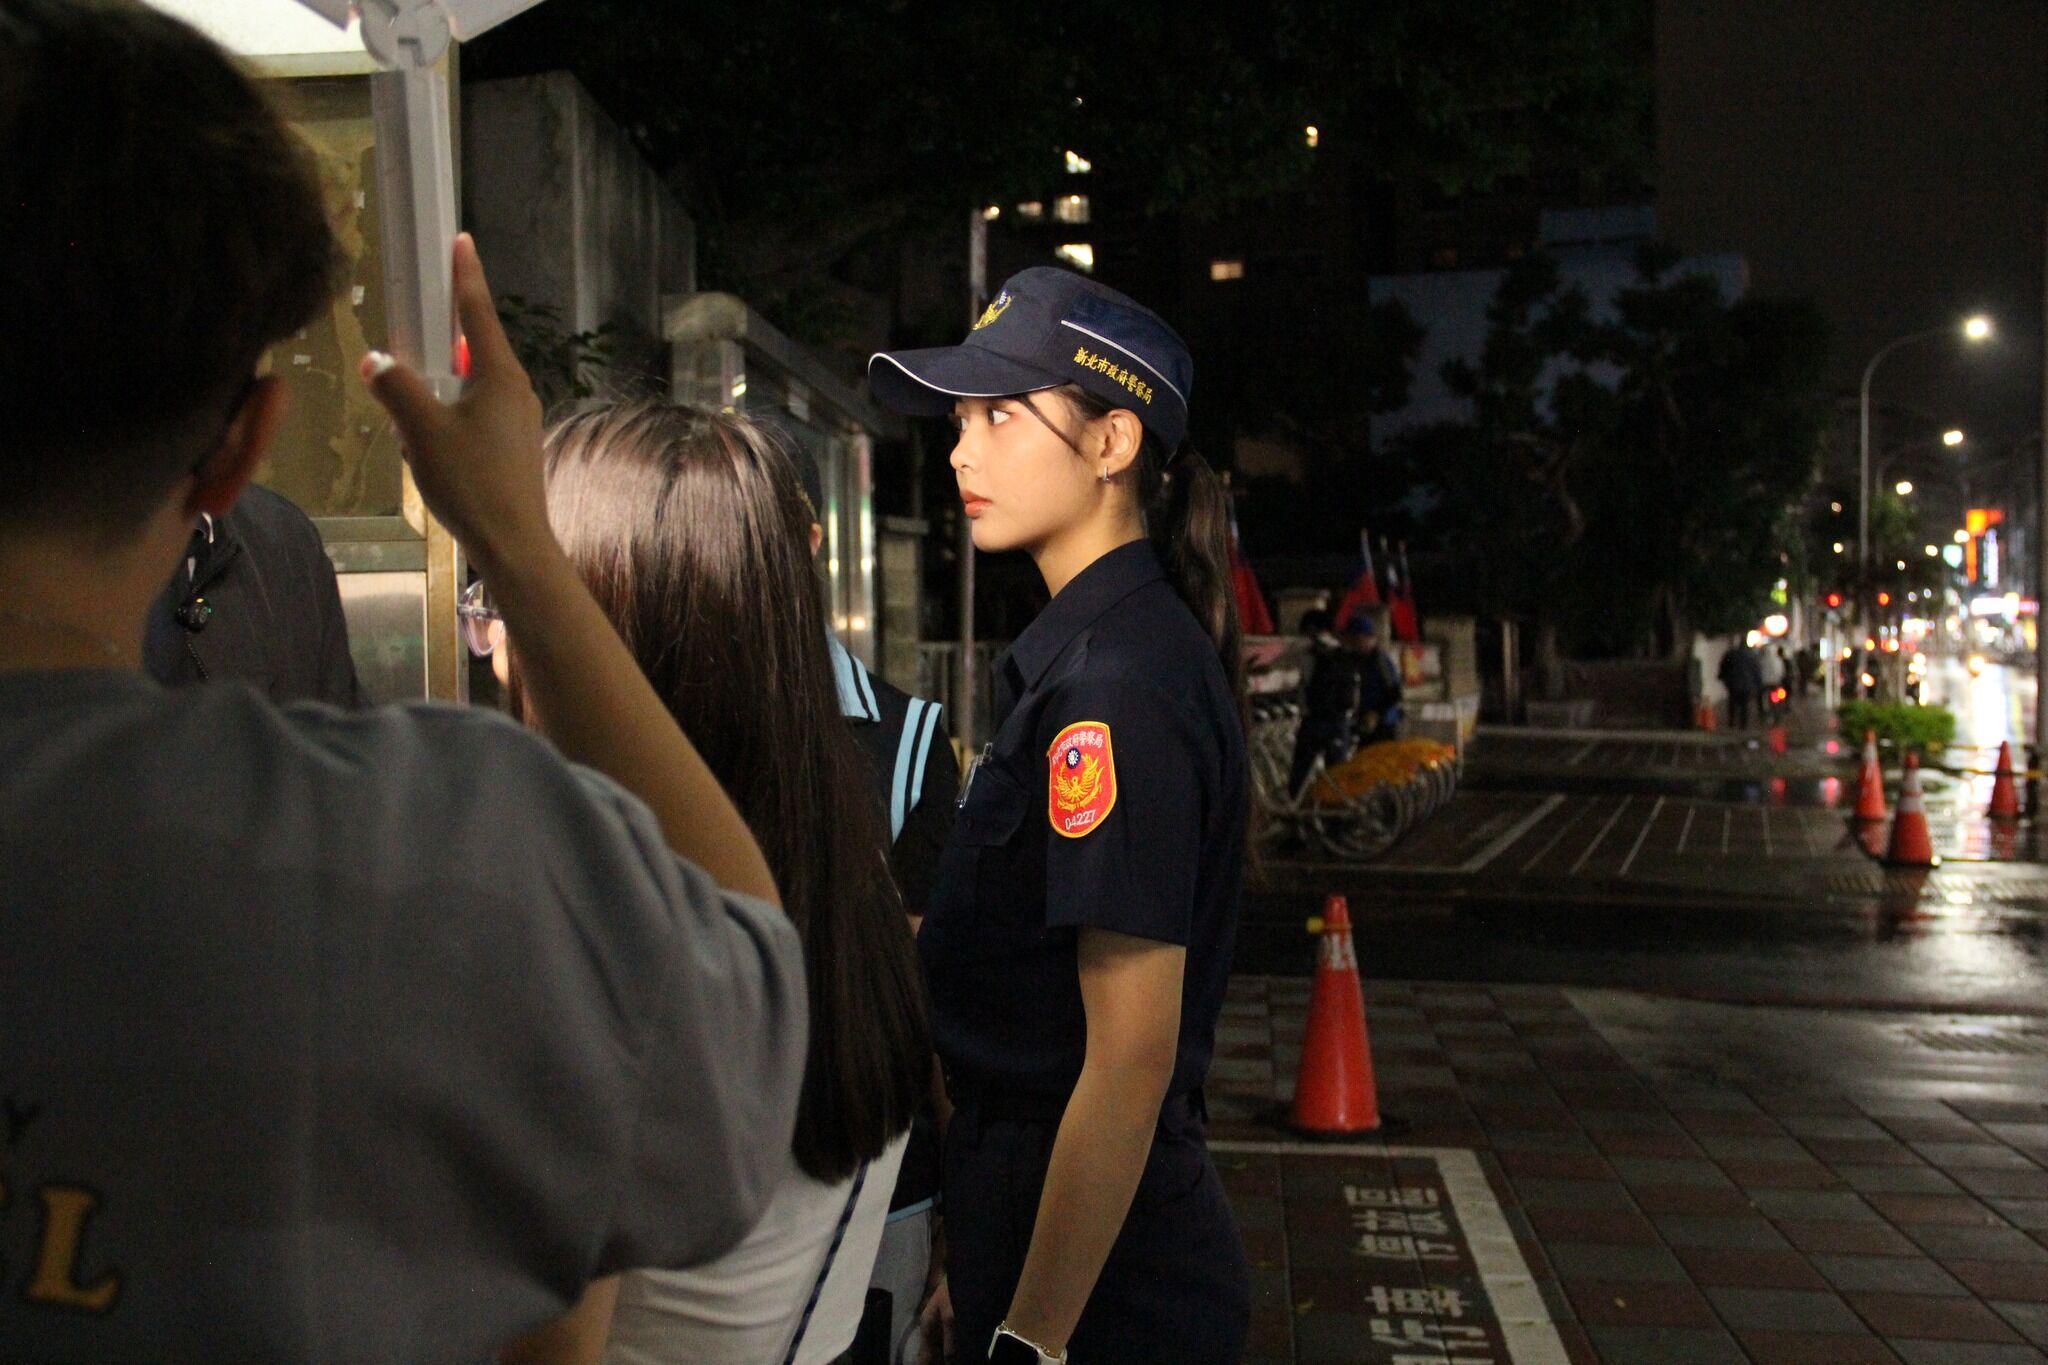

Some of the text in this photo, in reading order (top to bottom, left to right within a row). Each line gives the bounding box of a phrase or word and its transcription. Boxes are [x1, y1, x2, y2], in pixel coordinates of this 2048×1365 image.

[1073, 346, 1153, 405] 新北市政府警察局
[1065, 809, 1097, 831] 04227
[0, 1182, 119, 1313] L
